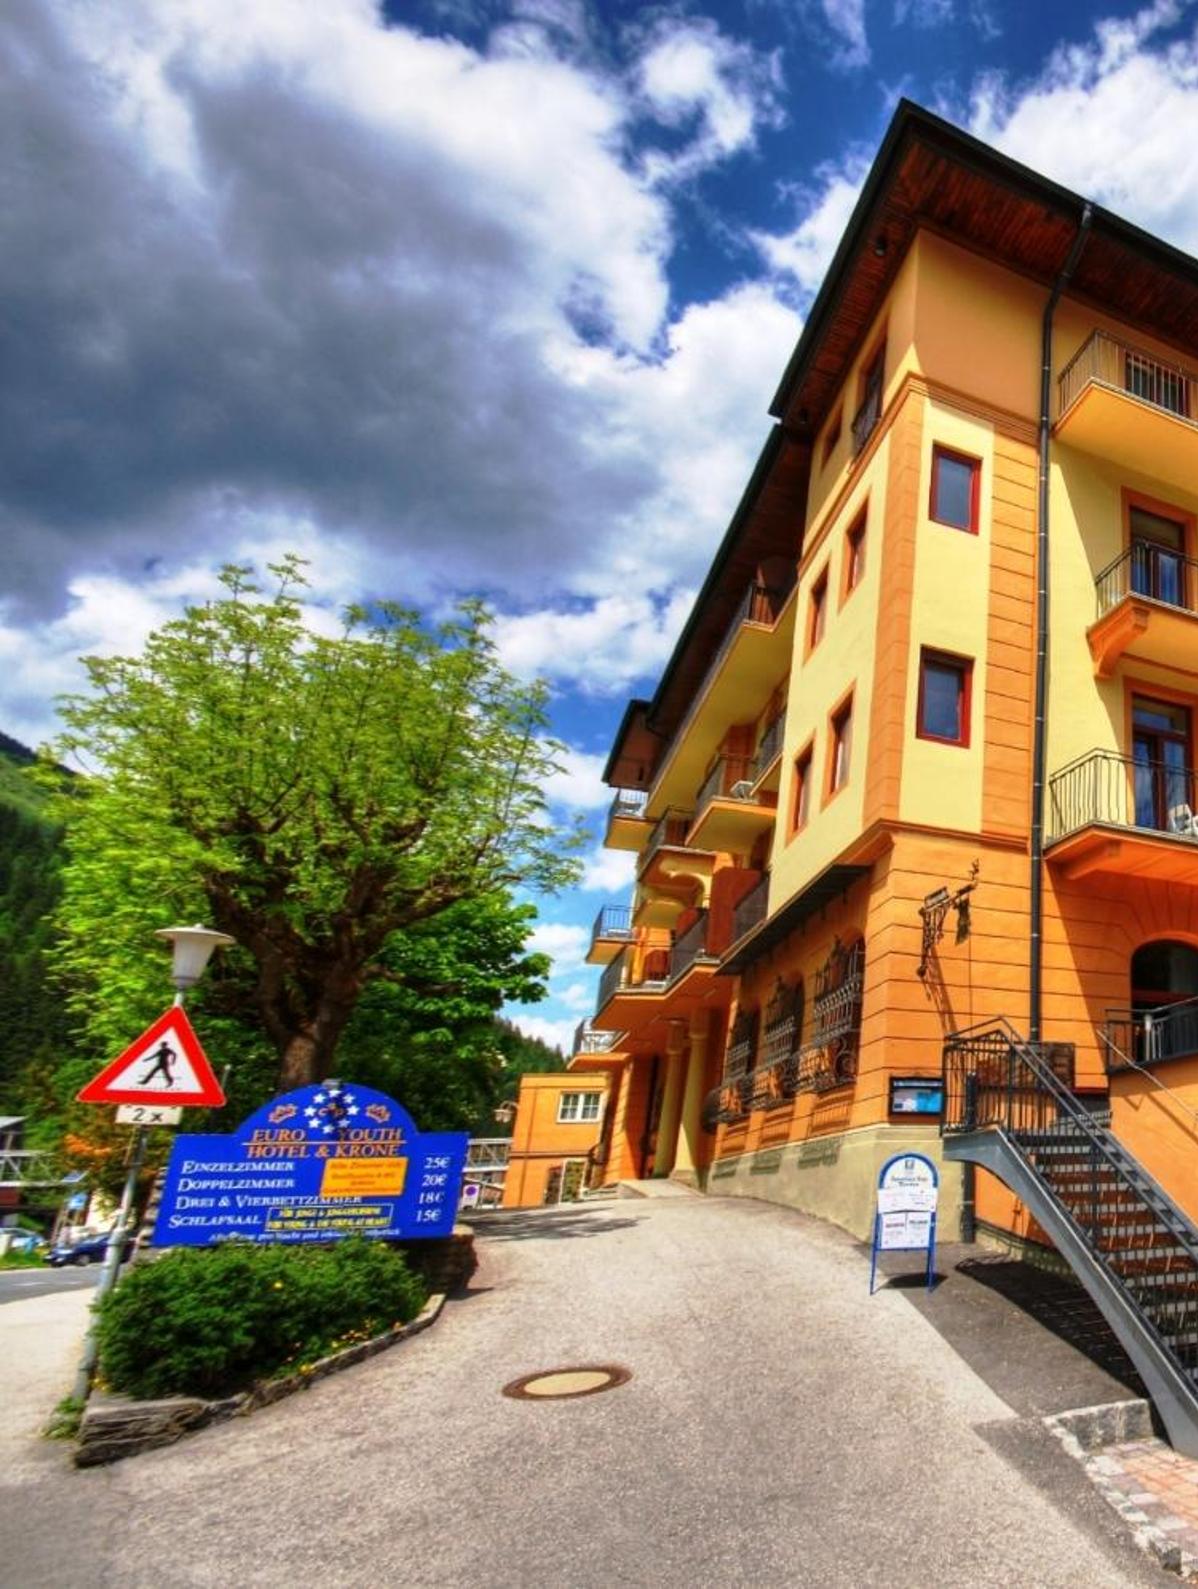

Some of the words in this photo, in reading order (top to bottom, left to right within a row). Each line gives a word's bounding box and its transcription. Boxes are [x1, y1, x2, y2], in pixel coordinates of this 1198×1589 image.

[132, 1107, 146, 1122] 2
[252, 1128, 306, 1142] EURO
[337, 1127, 402, 1142] YOUTH
[246, 1144, 311, 1159] HOTEL
[315, 1144, 330, 1158] &
[335, 1143, 400, 1158] KRONE
[181, 1160, 295, 1174] EINZELZIMMER
[424, 1156, 451, 1169] 25€
[178, 1178, 295, 1192] DOPPELZIMMER
[422, 1174, 448, 1187] 20€
[175, 1195, 215, 1210] DREI
[218, 1195, 231, 1208] &
[235, 1194, 363, 1209] VIERBETTZIMMER
[419, 1191, 445, 1205] 18€
[167, 1214, 262, 1229] SCHLAFSAAL
[416, 1209, 442, 1223] 15€
